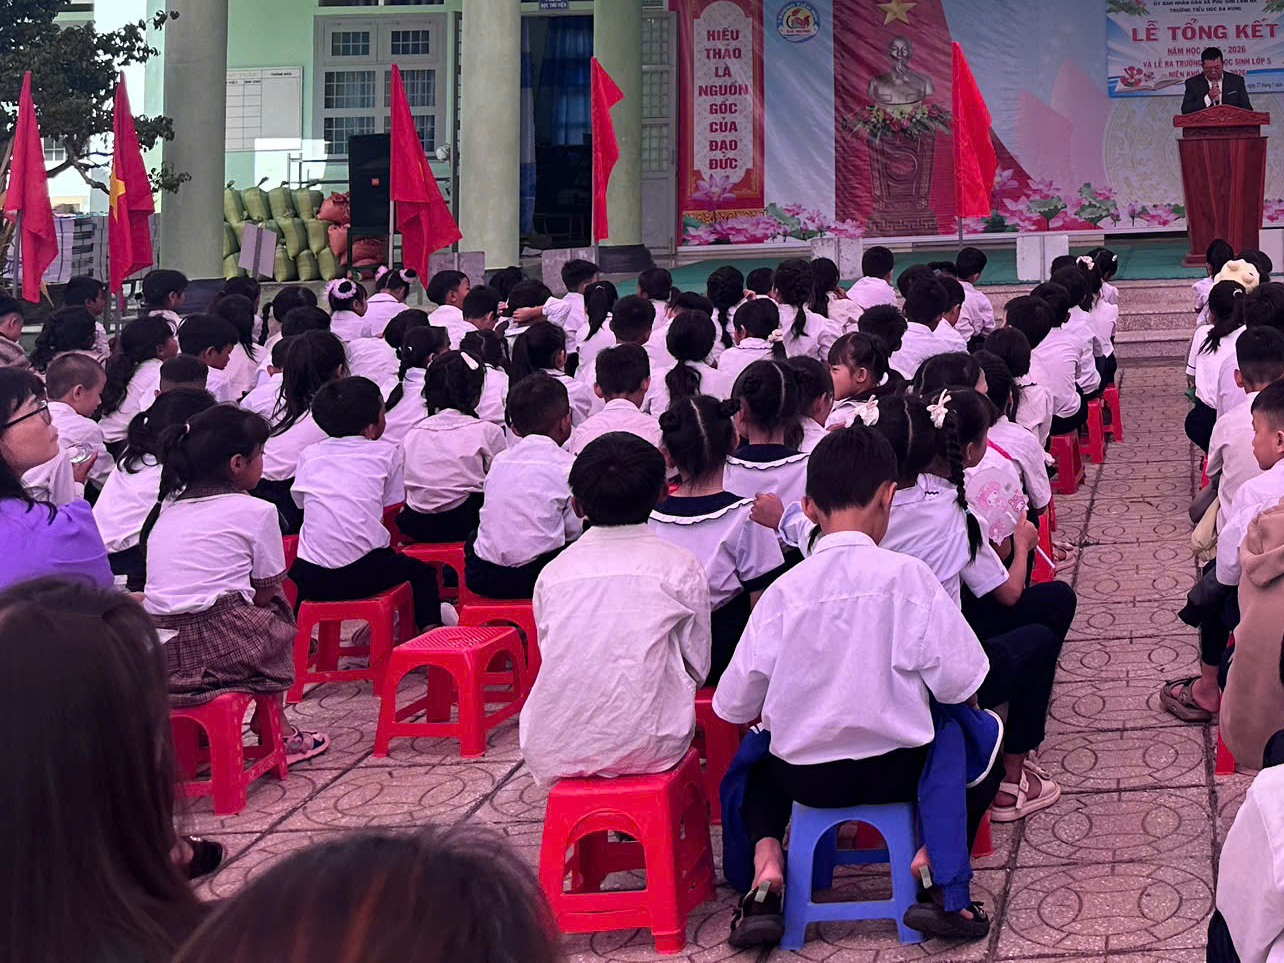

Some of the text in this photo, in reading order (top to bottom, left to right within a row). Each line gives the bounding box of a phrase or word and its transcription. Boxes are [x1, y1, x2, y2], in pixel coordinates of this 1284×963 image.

[1131, 18, 1279, 42] LỄ TỔNG KẾT
[1228, 45, 1246, 53] 2026
[709, 139, 738, 154] ĐẠO
